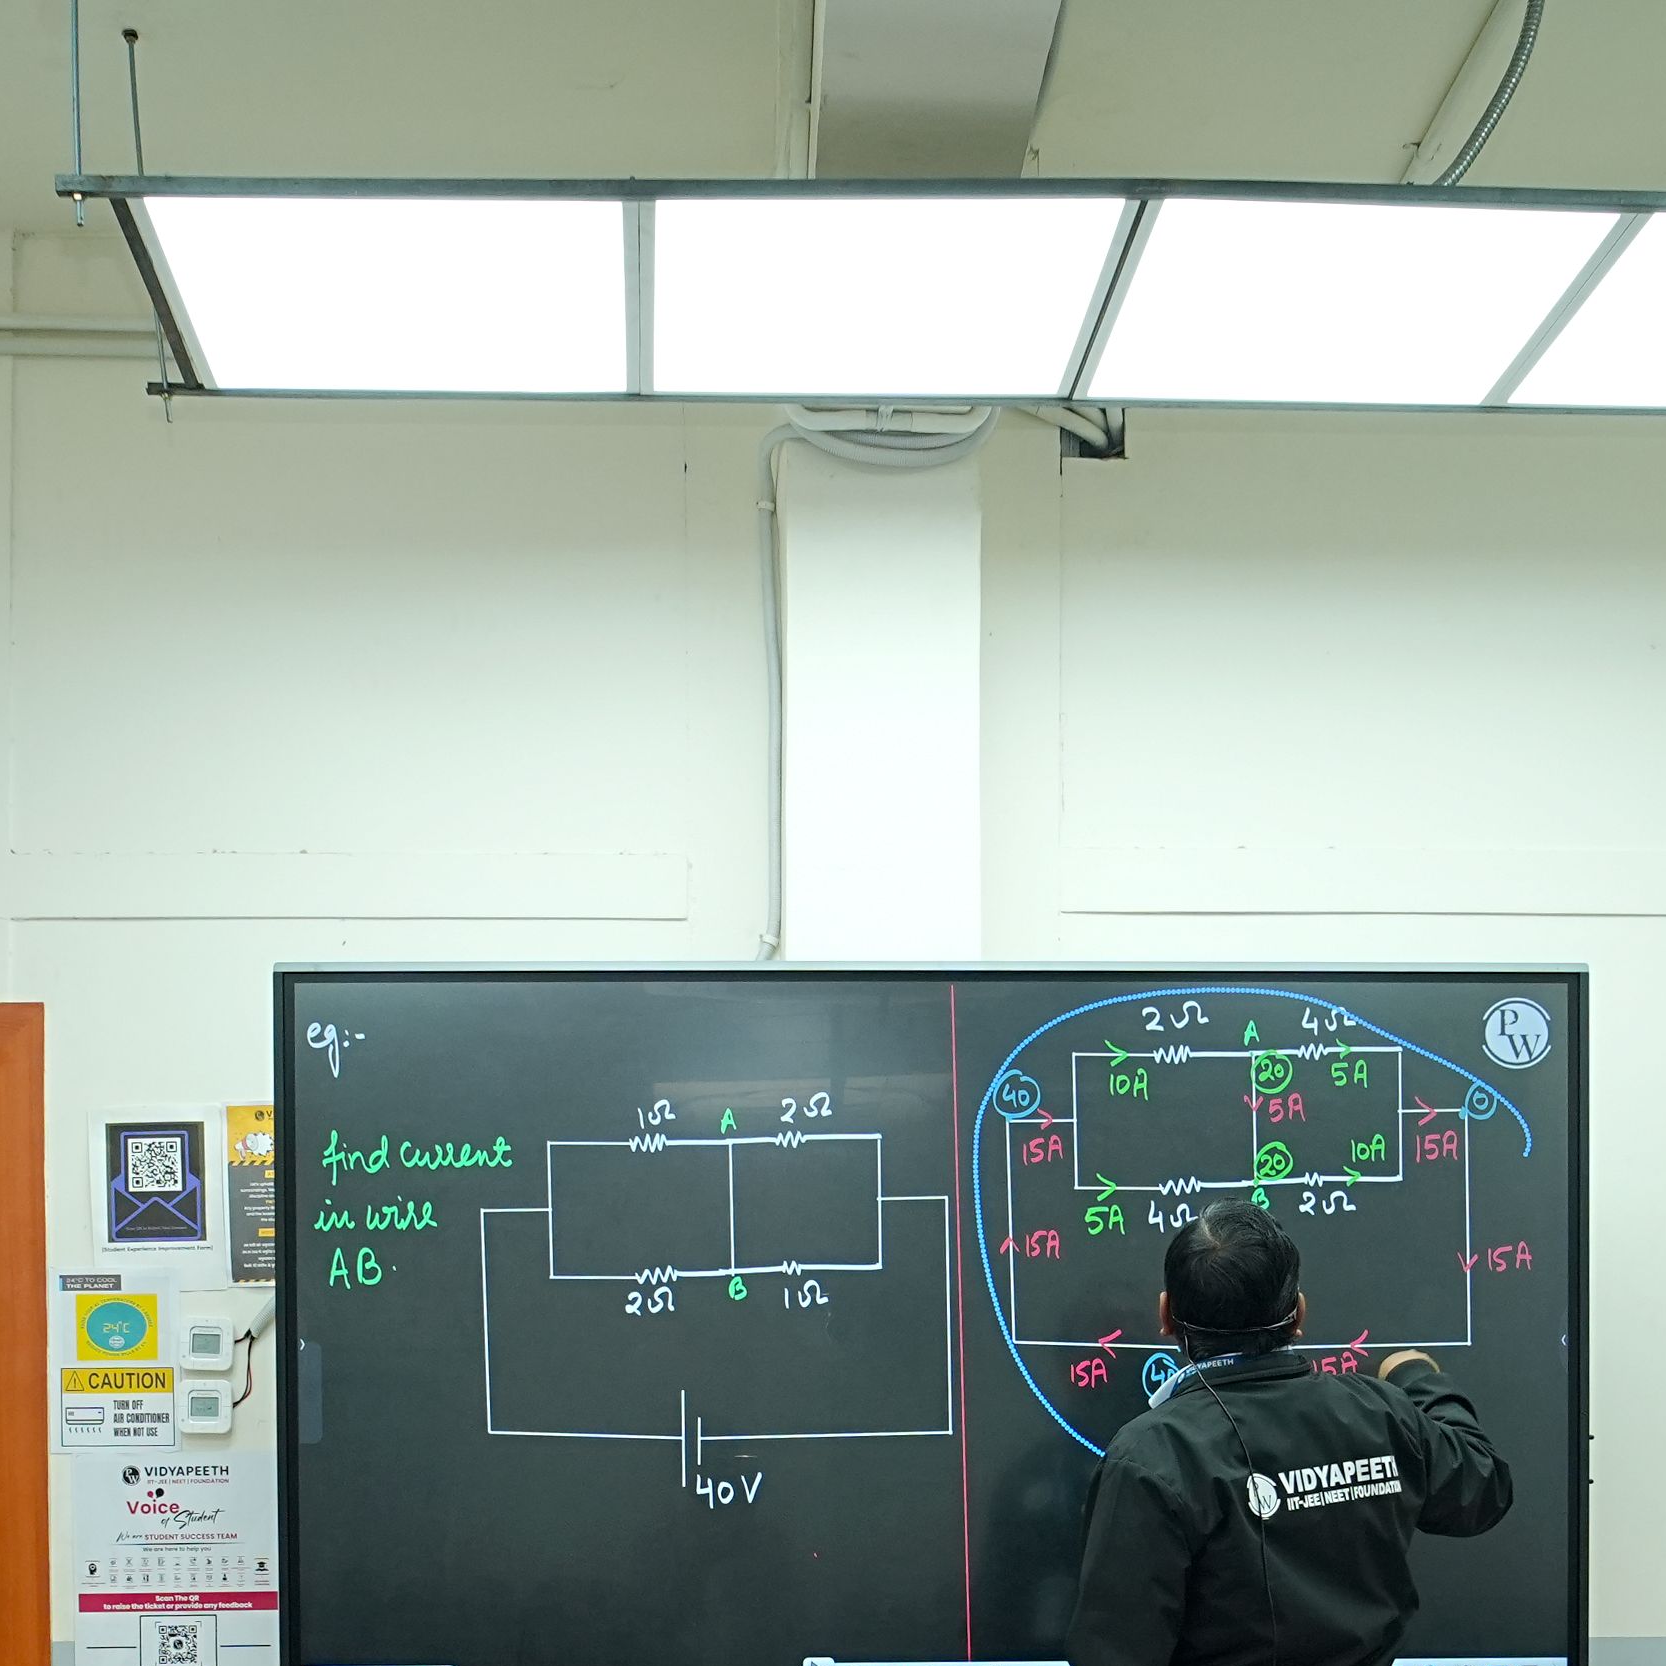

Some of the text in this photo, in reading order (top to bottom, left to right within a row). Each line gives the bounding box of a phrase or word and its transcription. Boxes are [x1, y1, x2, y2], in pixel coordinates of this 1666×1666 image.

[1243, 1020, 1261, 1045] A
[1497, 1008, 1542, 1061] PW
[1259, 1061, 1286, 1081] 20
[1329, 1060, 1369, 1089] 5A
[1001, 1082, 1032, 1108] 40
[1108, 1066, 1150, 1102] 10A
[719, 1107, 737, 1133] A
[1267, 1096, 1307, 1123] 5A
[321, 1131, 513, 1186] find current
[1021, 1136, 1065, 1166] 15A
[1350, 1132, 1388, 1163] 10A
[1414, 1129, 1459, 1164] 15A
[1259, 1151, 1286, 1173] 20
[1250, 1186, 1271, 1210] B
[365, 1200, 438, 1232] wire
[1083, 1205, 1127, 1237] 5A
[1024, 1229, 1062, 1261] 15A
[1487, 1241, 1534, 1270] 15A
[728, 1275, 748, 1300] B
[1069, 1361, 1109, 1390] 15A
[1196, 1358, 1235, 1371] YAPEETH
[1310, 1351, 1359, 1376] 15A
[88, 1372, 166, 1390] CAUTION
[113, 1399, 144, 1410] TURN OFF
[113, 1412, 170, 1424] AIR CONDITIONER
[113, 1427, 158, 1437] WHEN NOT USE
[144, 1465, 229, 1477] VIDYAPEETH
[126, 1499, 180, 1515] Voice
[1286, 1492, 1322, 1511] IIT-JEE
[1324, 1487, 1351, 1504] NEET
[173, 1508, 226, 1530] Student
[144, 1533, 179, 1541] STUDENT
[217, 1532, 238, 1540] TEAM
[174, 1603, 203, 1611] provide
[218, 1601, 253, 1609] feedback
